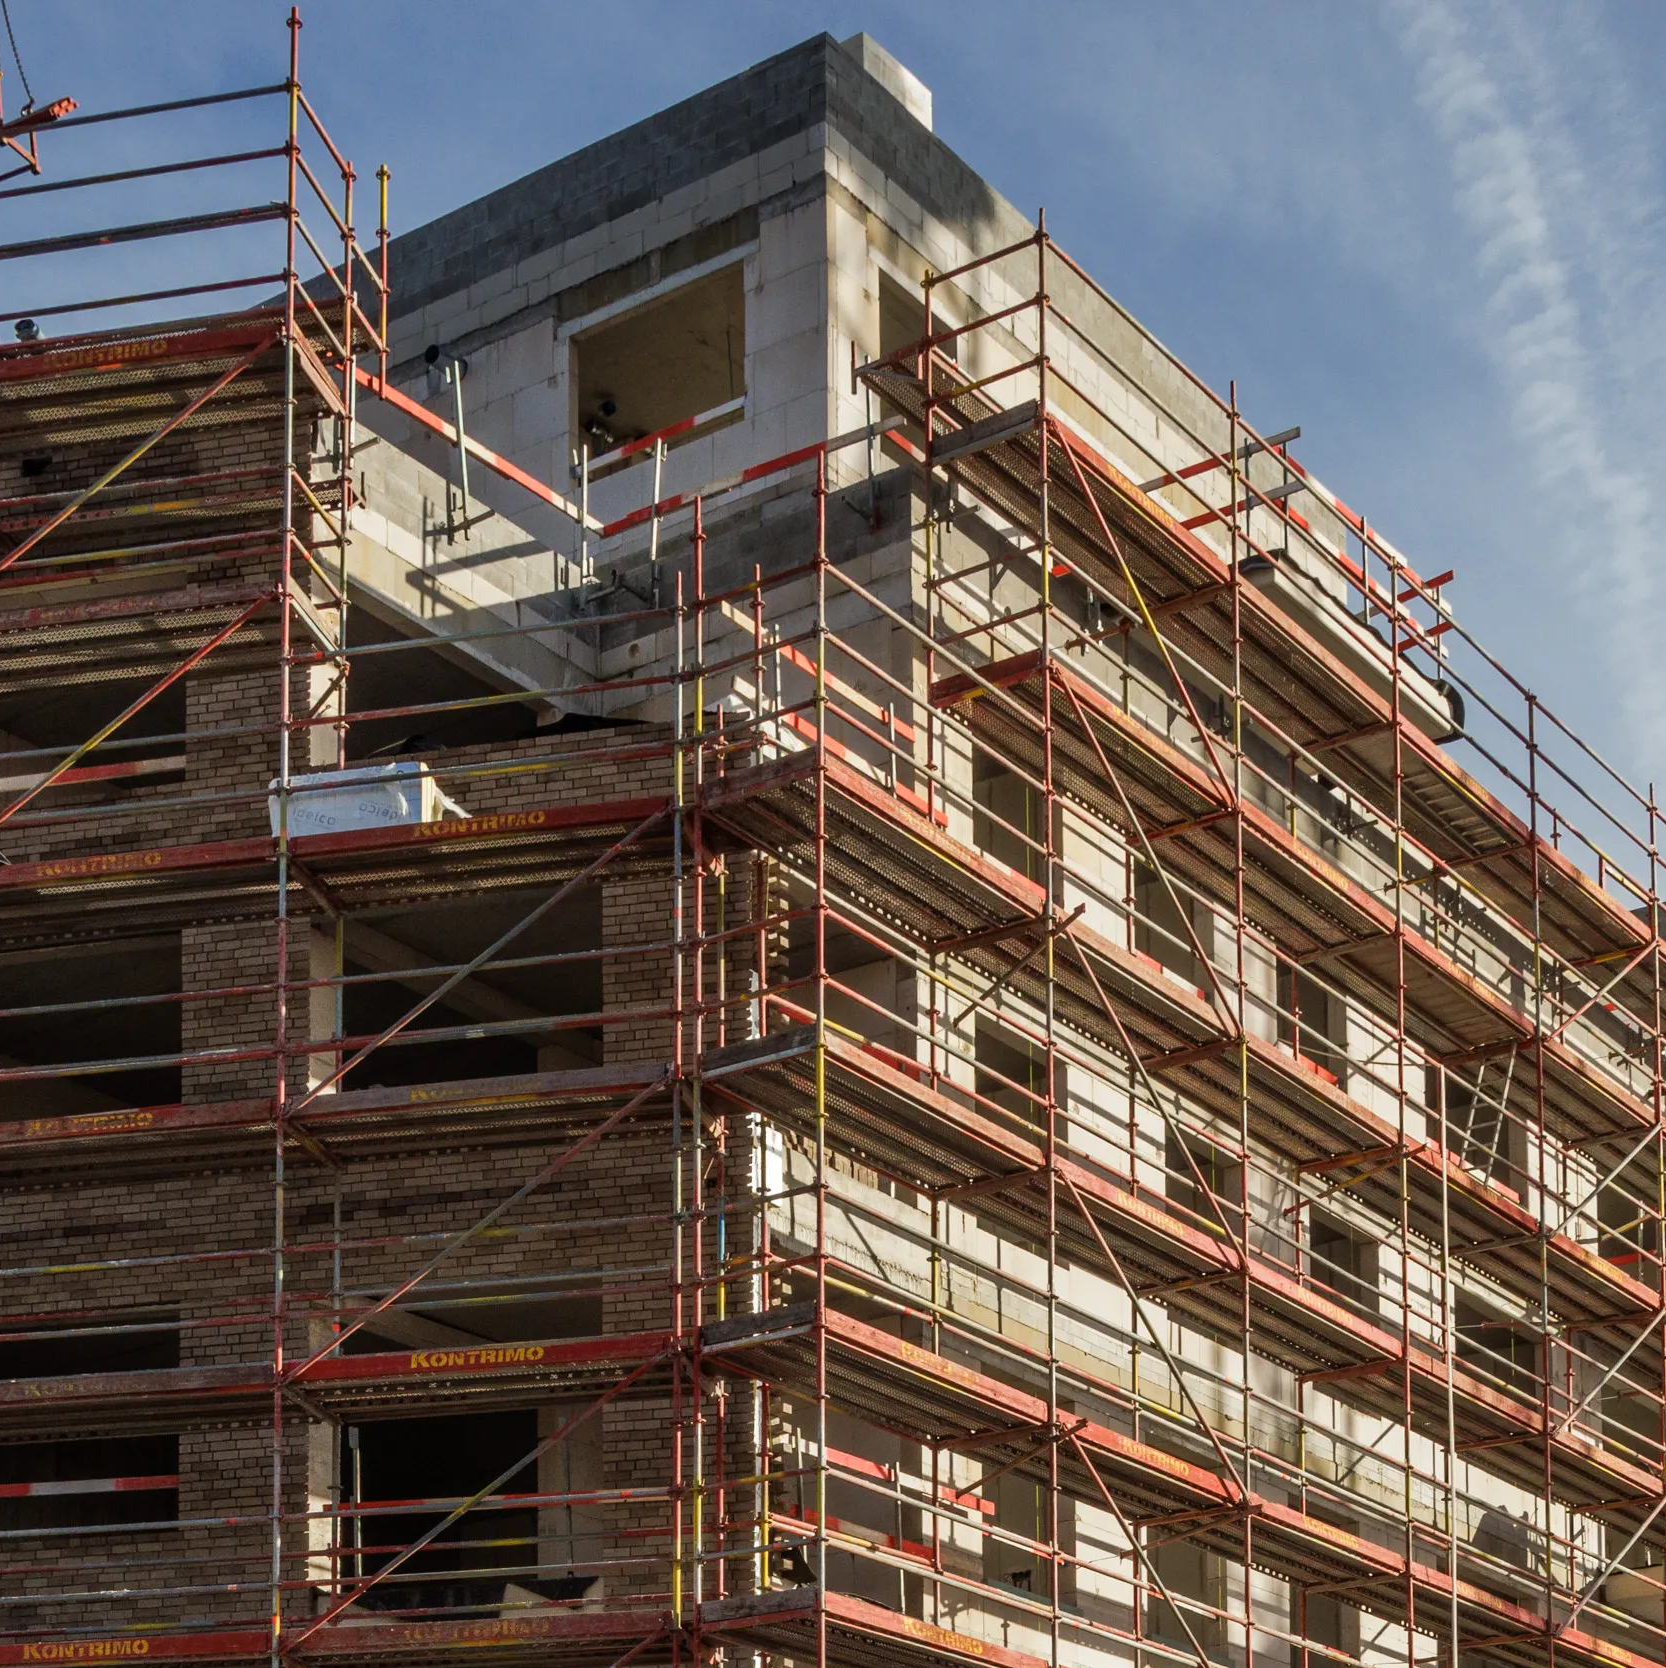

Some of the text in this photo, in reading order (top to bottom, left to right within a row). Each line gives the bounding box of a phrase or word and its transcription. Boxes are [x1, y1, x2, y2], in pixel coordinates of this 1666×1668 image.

[413, 809, 546, 837] KONTRIMO
[411, 1346, 544, 1370] KONTRIMO
[1122, 1436, 1190, 1477] KONTRIMO
[23, 1638, 149, 1660] KONTRIMO
